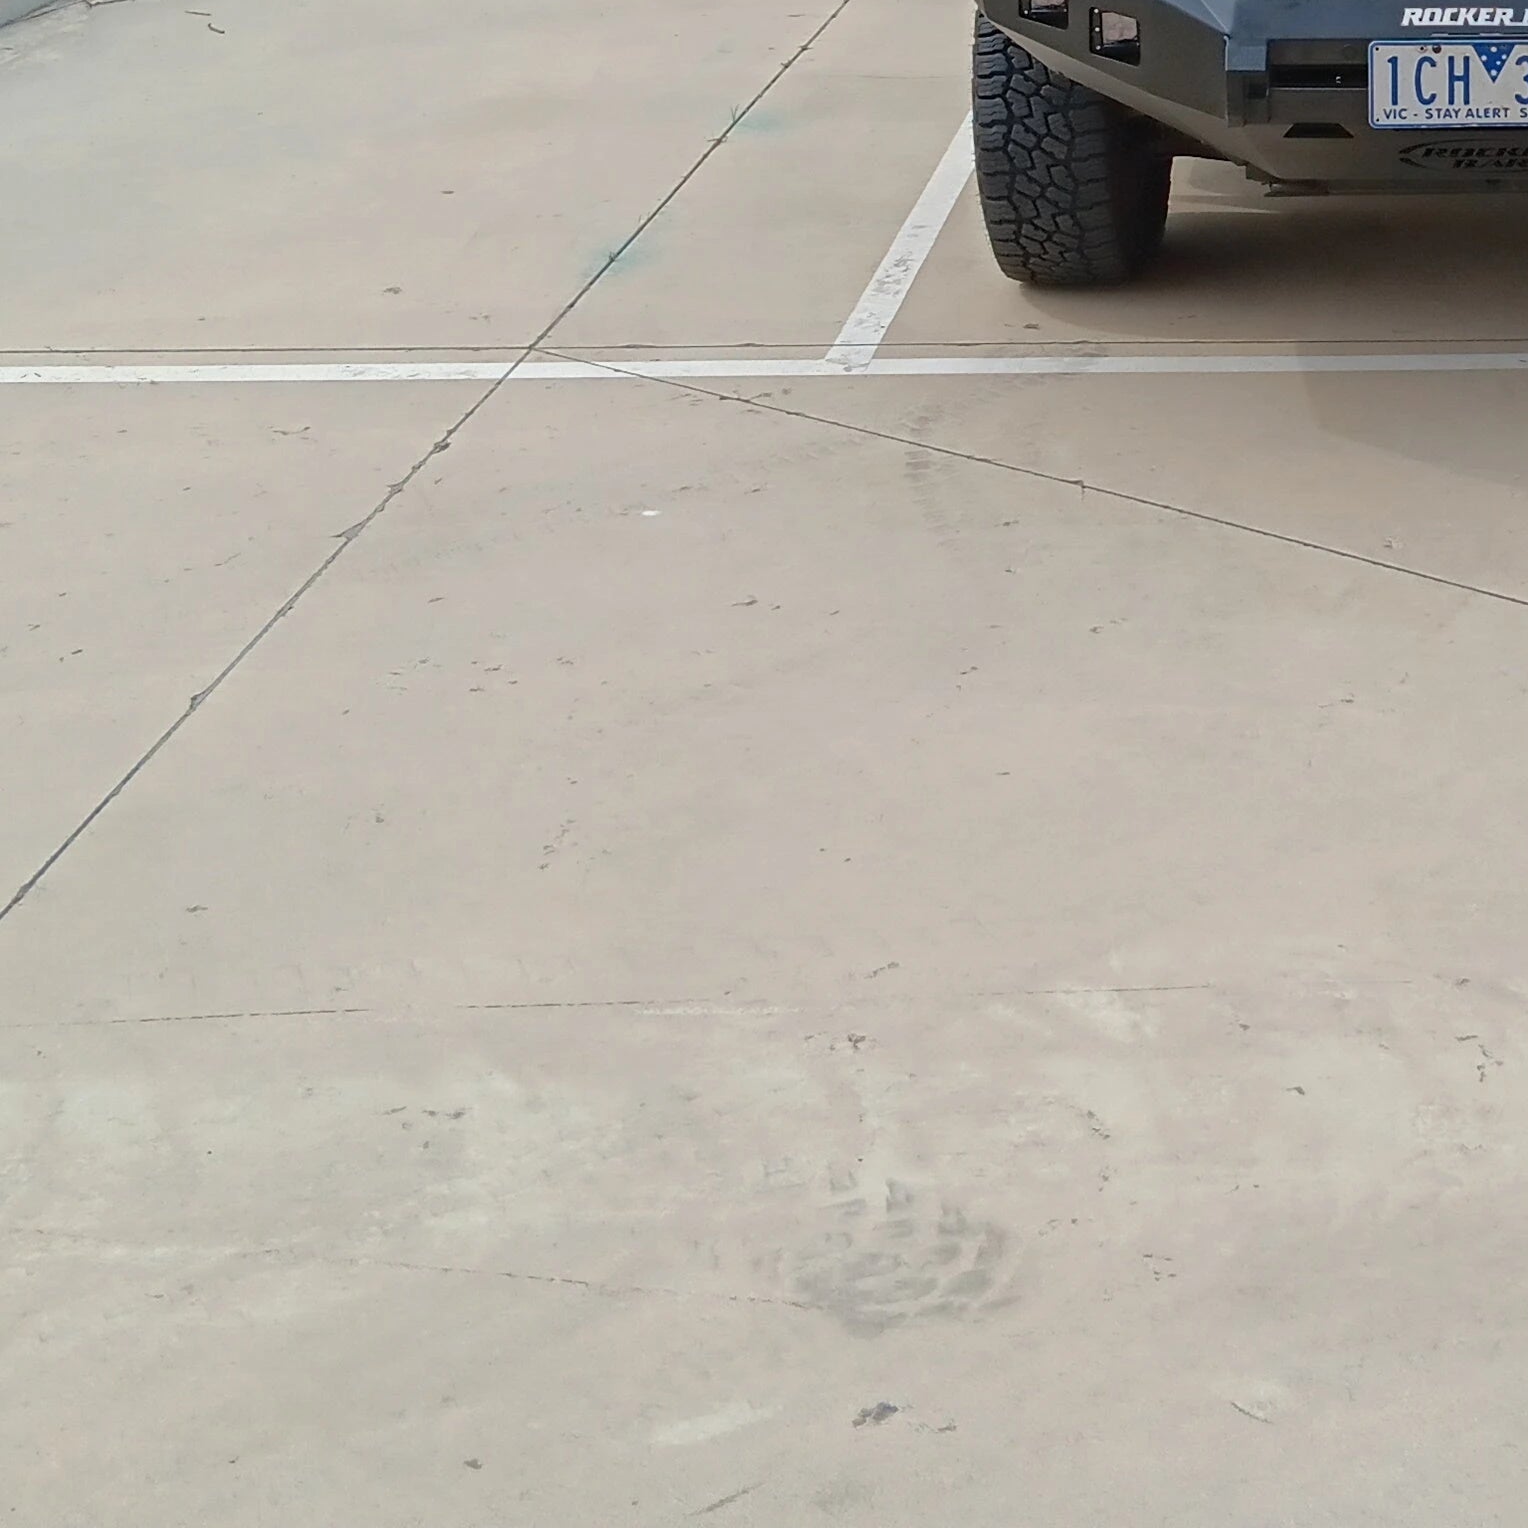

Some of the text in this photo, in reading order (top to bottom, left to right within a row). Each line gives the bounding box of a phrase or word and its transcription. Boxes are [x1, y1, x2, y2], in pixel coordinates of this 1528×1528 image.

[1400, 7, 1514, 27] ROCKER
[1387, 55, 1470, 106] 1CH
[1383, 108, 1408, 120] VIC
[1425, 108, 1462, 119] STAY
[1465, 107, 1511, 119] ALERT
